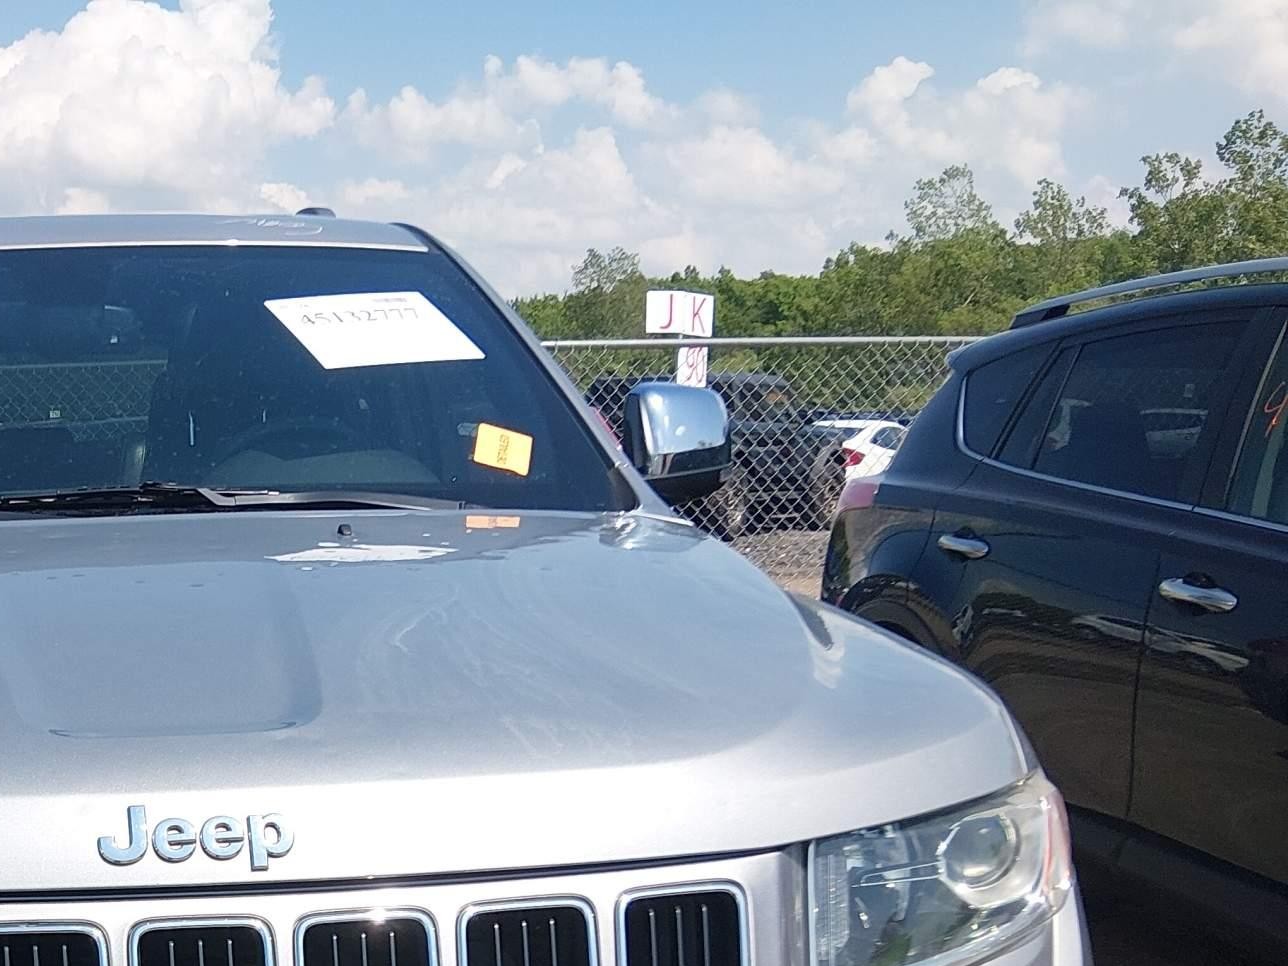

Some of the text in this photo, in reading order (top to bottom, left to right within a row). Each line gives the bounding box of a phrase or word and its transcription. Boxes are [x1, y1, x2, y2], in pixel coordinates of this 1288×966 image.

[300, 307, 419, 326] 45132777
[659, 293, 707, 334] J K
[97, 804, 295, 872] Jeep
